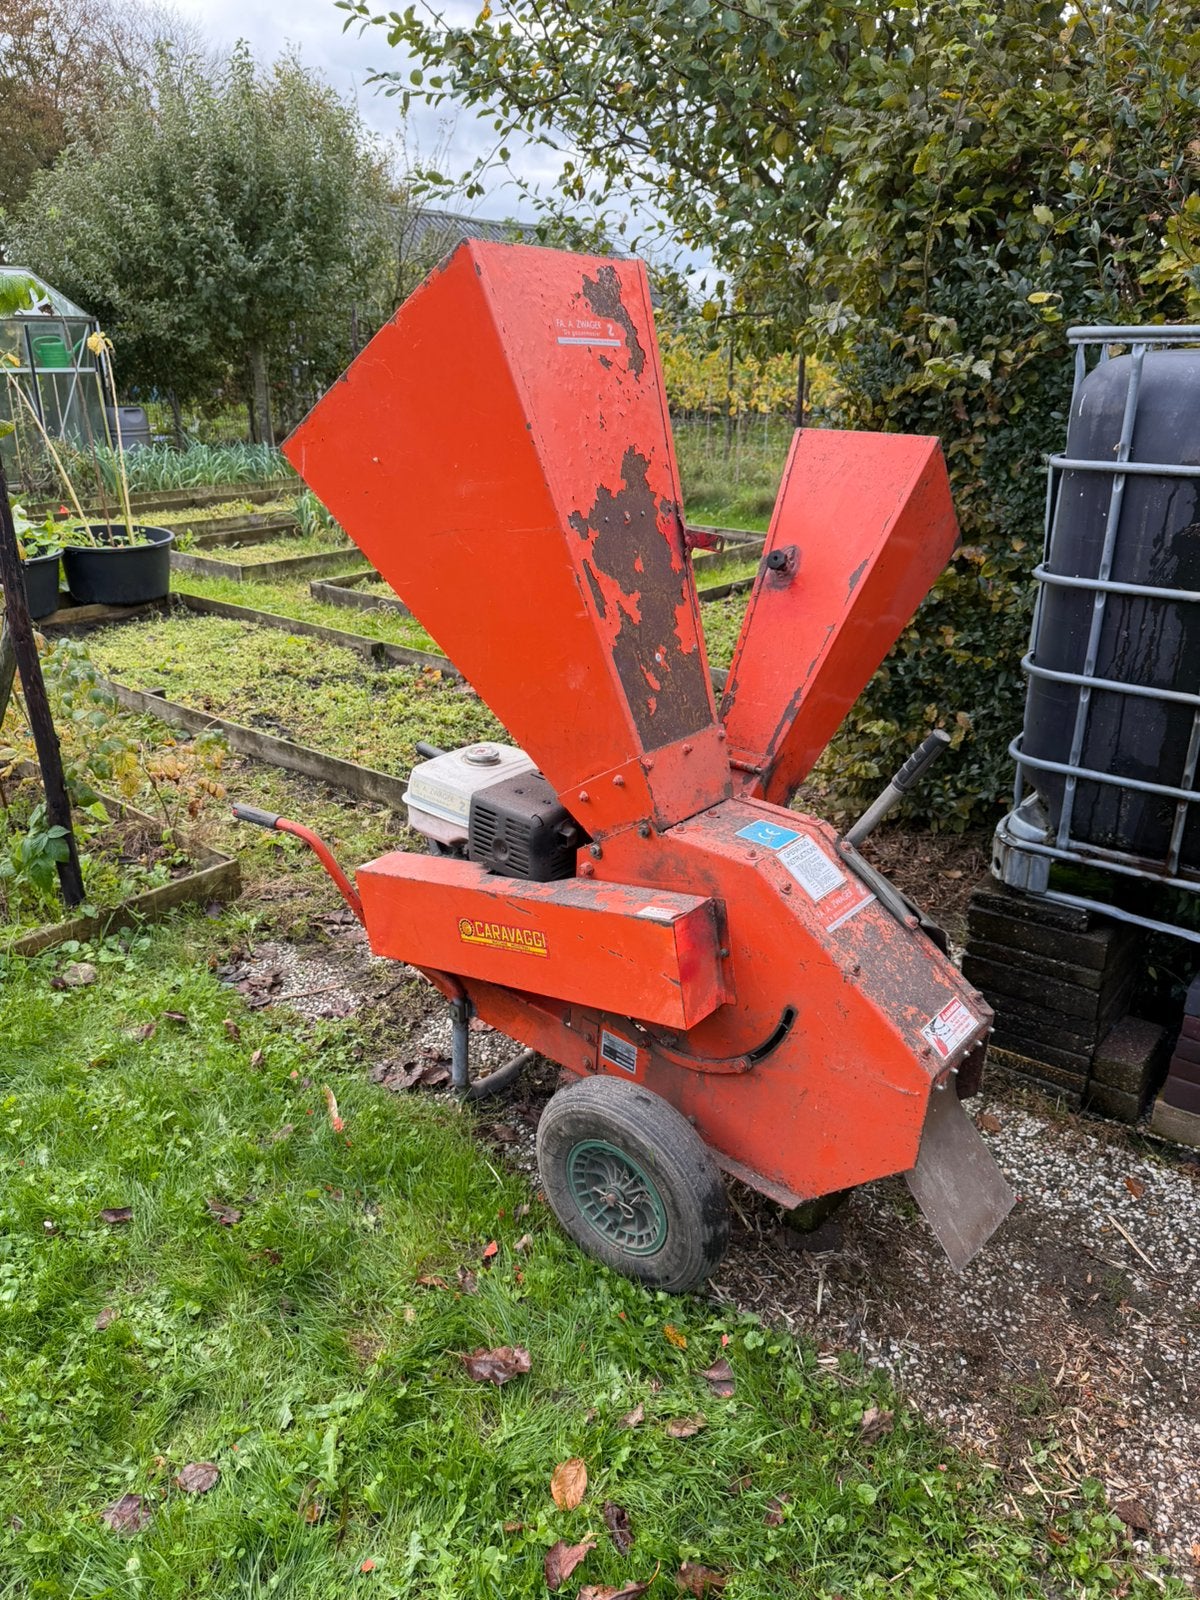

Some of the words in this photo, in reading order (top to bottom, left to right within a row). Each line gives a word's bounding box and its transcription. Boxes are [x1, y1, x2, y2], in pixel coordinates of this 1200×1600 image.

[783, 840, 810, 859] OPERATING
[787, 846, 818, 867] INSTRUCTIONS
[474, 921, 546, 948] CARAVAGGI
